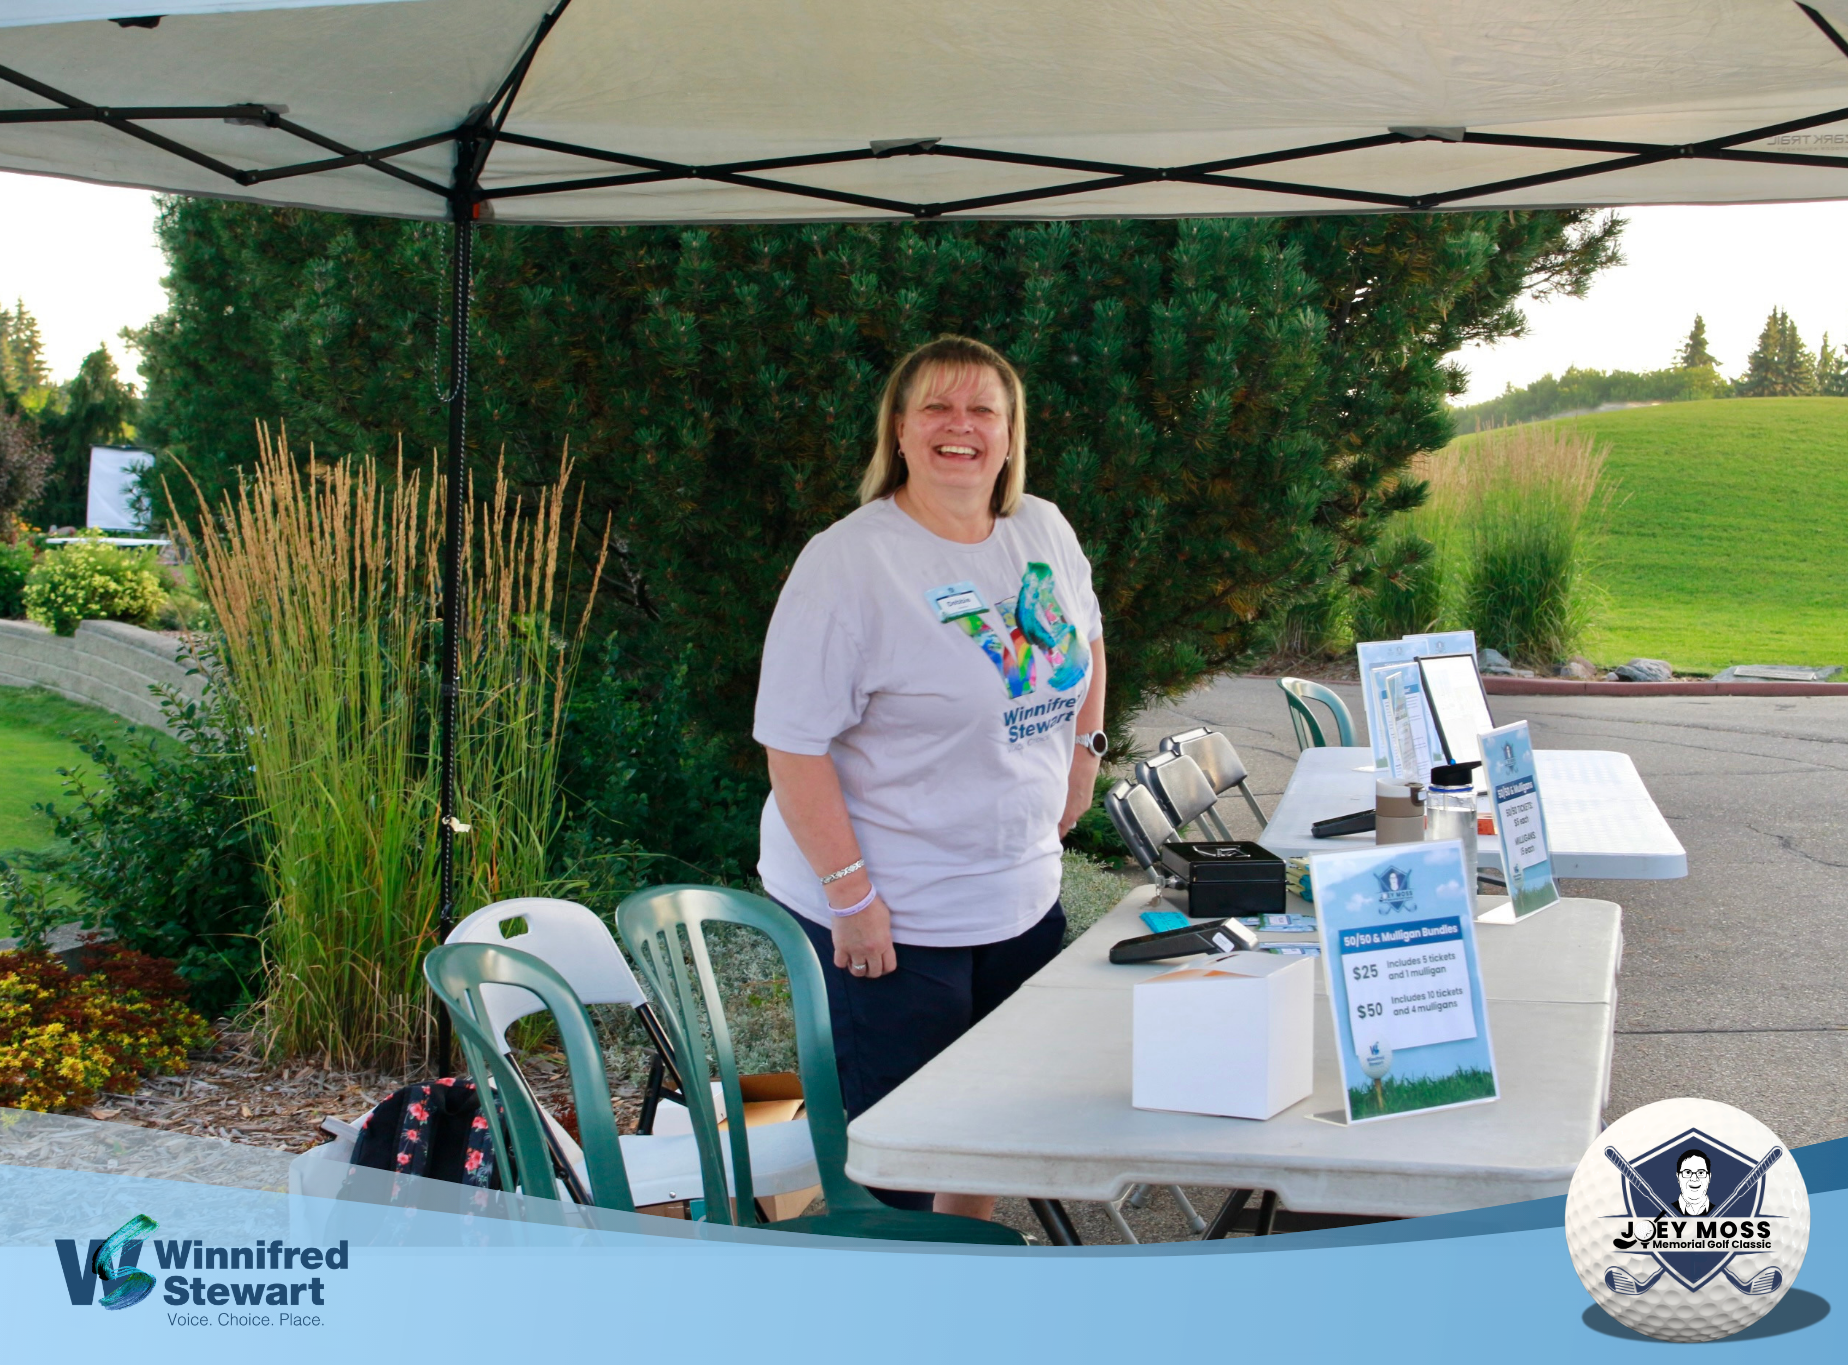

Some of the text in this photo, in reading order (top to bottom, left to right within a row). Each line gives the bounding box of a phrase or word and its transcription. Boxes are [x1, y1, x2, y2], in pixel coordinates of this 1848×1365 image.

[1004, 691, 1082, 726] Winnifre
[1008, 711, 1075, 743] Stewart
[1514, 781, 1533, 794] Mulligans
[1520, 815, 1529, 825] each
[1525, 845, 1535, 854] each
[1344, 924, 1458, 947] 50/50 & Mulligan Bundles
[1387, 952, 1456, 968] Includes 5 tickets
[1352, 963, 1379, 981] $25
[1388, 969, 1404, 980] and
[1410, 965, 1446, 979] mulligan
[1391, 987, 1463, 1005] Includes 10 tickets
[1357, 1002, 1383, 1020] $50
[1393, 1000, 1458, 1016] and 4 mulligans
